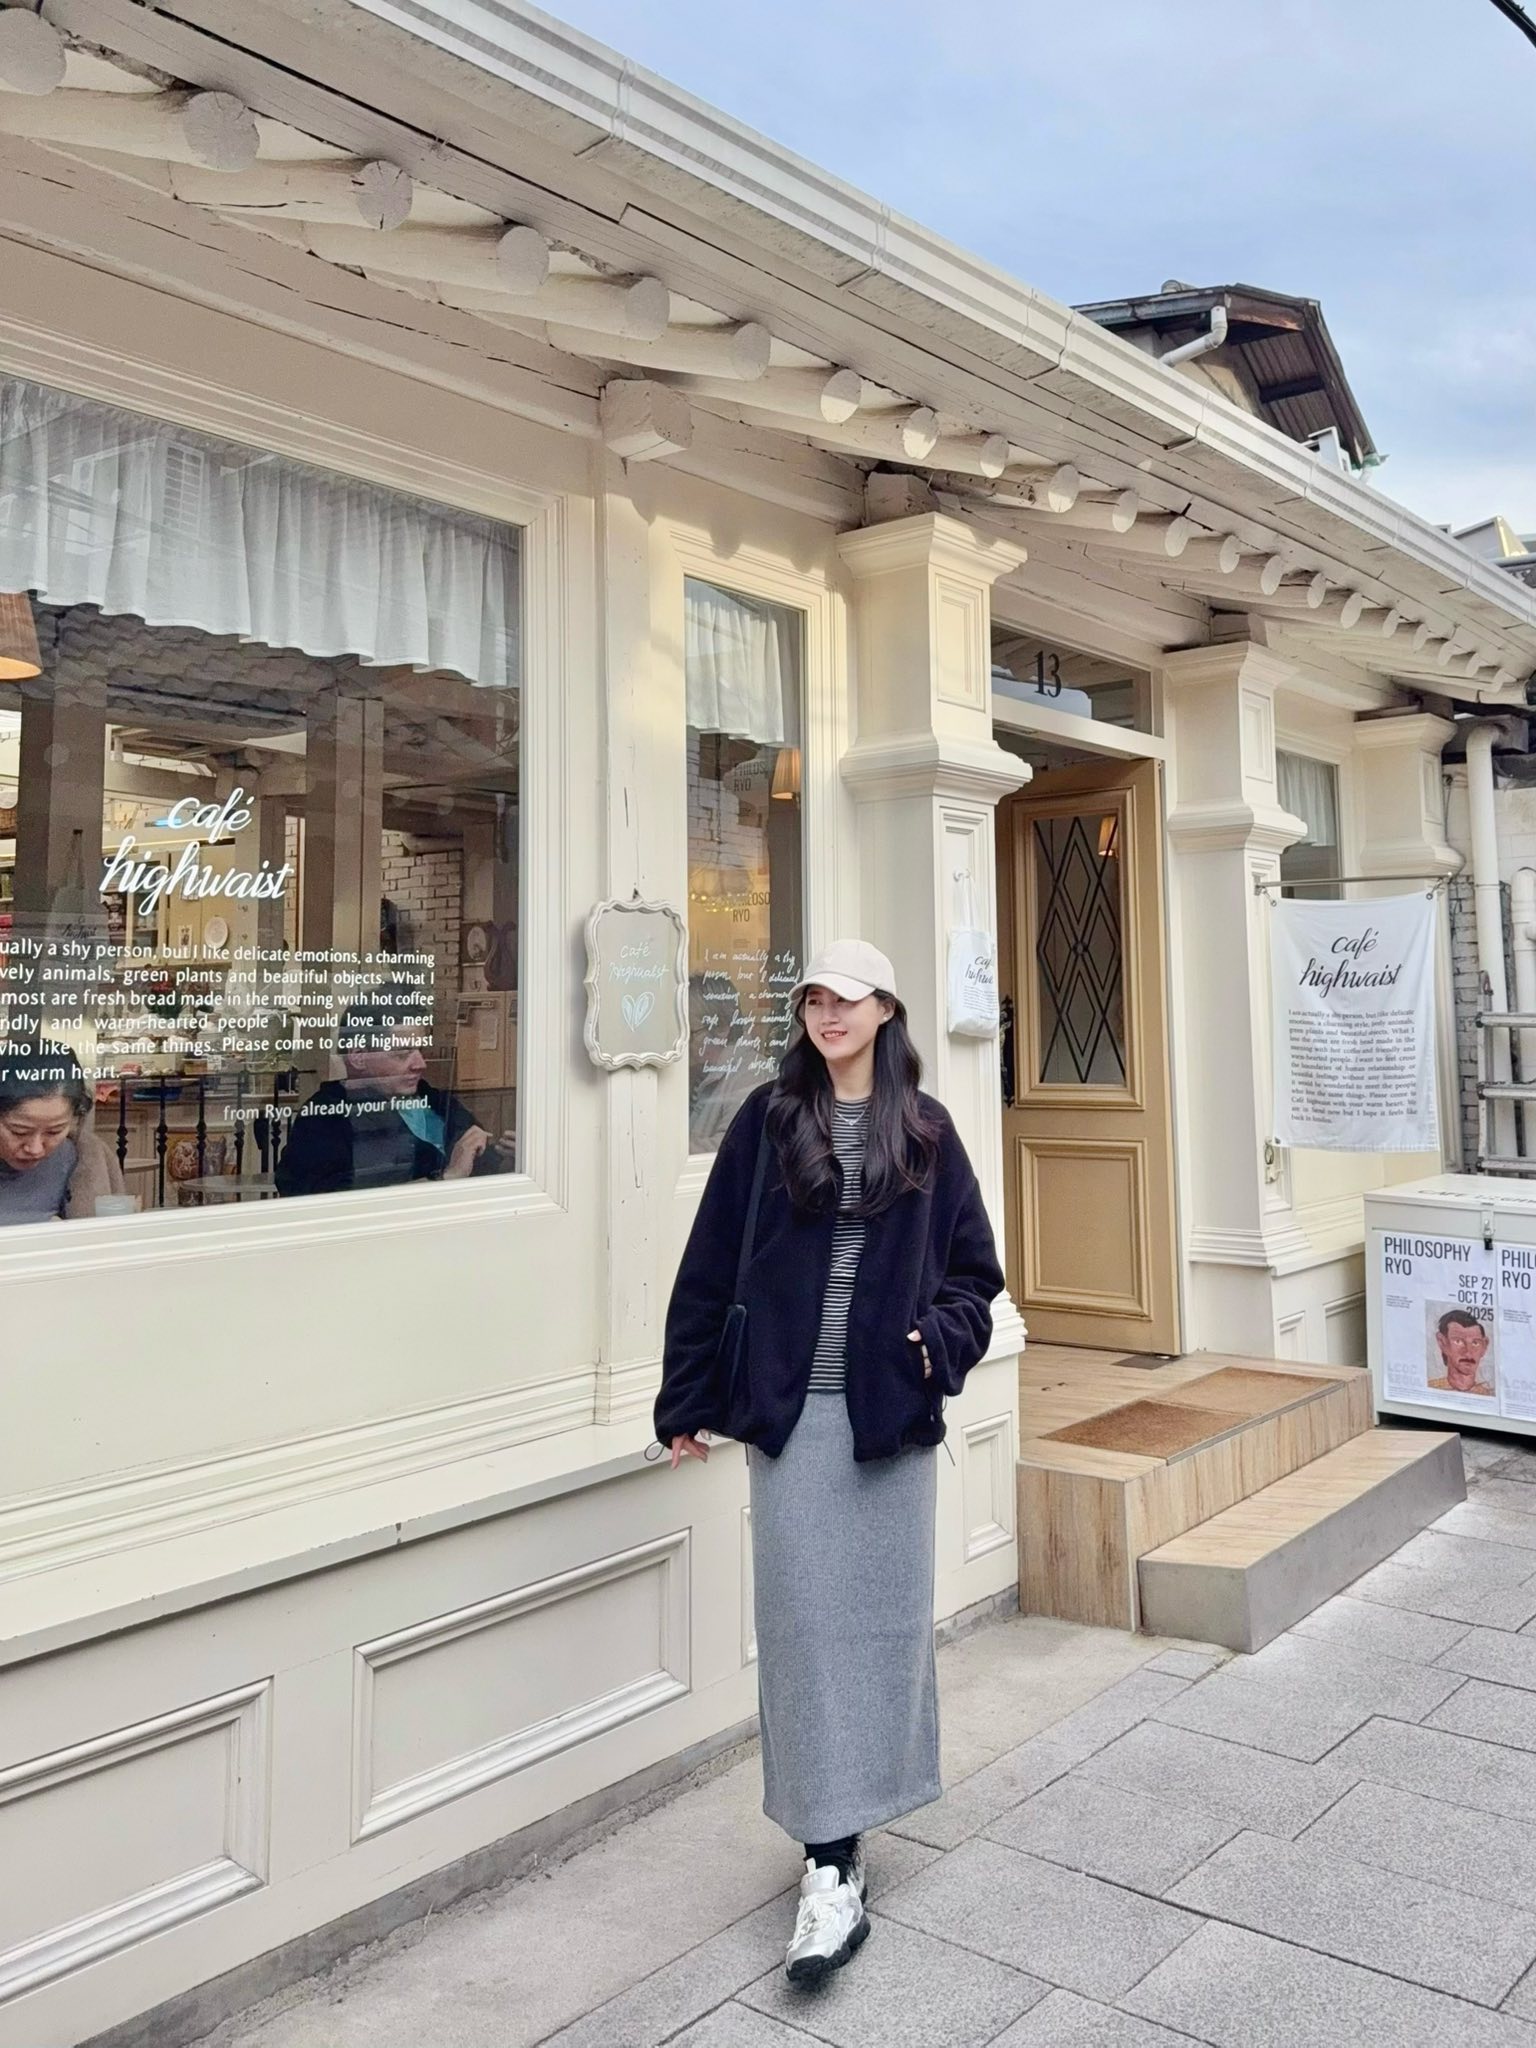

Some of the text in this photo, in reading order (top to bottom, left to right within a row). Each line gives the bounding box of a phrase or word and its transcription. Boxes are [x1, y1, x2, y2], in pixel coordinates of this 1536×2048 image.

[1034, 650, 1061, 698] 13
[99, 835, 295, 916] highwaist
[733, 909, 750, 923] RYO
[48, 944, 57, 955] a
[62, 940, 92, 960] shy
[96, 943, 157, 960] person,
[162, 944, 188, 959] but
[202, 944, 229, 960] like
[234, 946, 290, 962] delicate
[294, 949, 361, 965] emotions,
[365, 953, 373, 963] a
[376, 950, 435, 968] charming
[42, 965, 115, 983] animals,
[123, 969, 169, 985] green
[176, 967, 223, 985] plants
[229, 969, 256, 983] and
[263, 969, 327, 984] beautiful
[333, 972, 386, 988] objects.
[391, 971, 425, 985] What
[430, 972, 434, 985] I
[1299, 957, 1404, 999] highwaist
[1, 990, 434, 1009] most are fresh bread made in the morning with hot coffee
[51, 1015, 83, 1030] and
[94, 1015, 208, 1031] warm-hearted
[282, 1015, 287, 1028] I
[296, 1013, 339, 1028] would
[347, 1013, 374, 1027] love
[382, 1015, 395, 1027] to
[402, 1014, 433, 1027] meet
[39, 1039, 70, 1056] like
[76, 1039, 105, 1055] the
[112, 1042, 155, 1055] same
[162, 1037, 214, 1057] things.
[222, 1037, 269, 1052] Please
[274, 1038, 314, 1051] come
[319, 1038, 333, 1050] to
[338, 1035, 366, 1049] café
[371, 1034, 433, 1051] highwiast
[15, 1066, 65, 1081] warm
[71, 1063, 120, 1080] heart.
[223, 1105, 259, 1121] from
[300, 1100, 351, 1118] already
[356, 1099, 385, 1117] your
[390, 1095, 431, 1111] friend.
[1384, 1236, 1471, 1262] PHILOSOPHY
[1502, 1249, 1536, 1269] PHIL
[1384, 1256, 1412, 1276] RYO
[1458, 1274, 1494, 1290] SEP 27
[1502, 1270, 1531, 1290] RYO
[1481, 1292, 1493, 1306] 21
[1466, 1306, 1494, 1322] 2025
